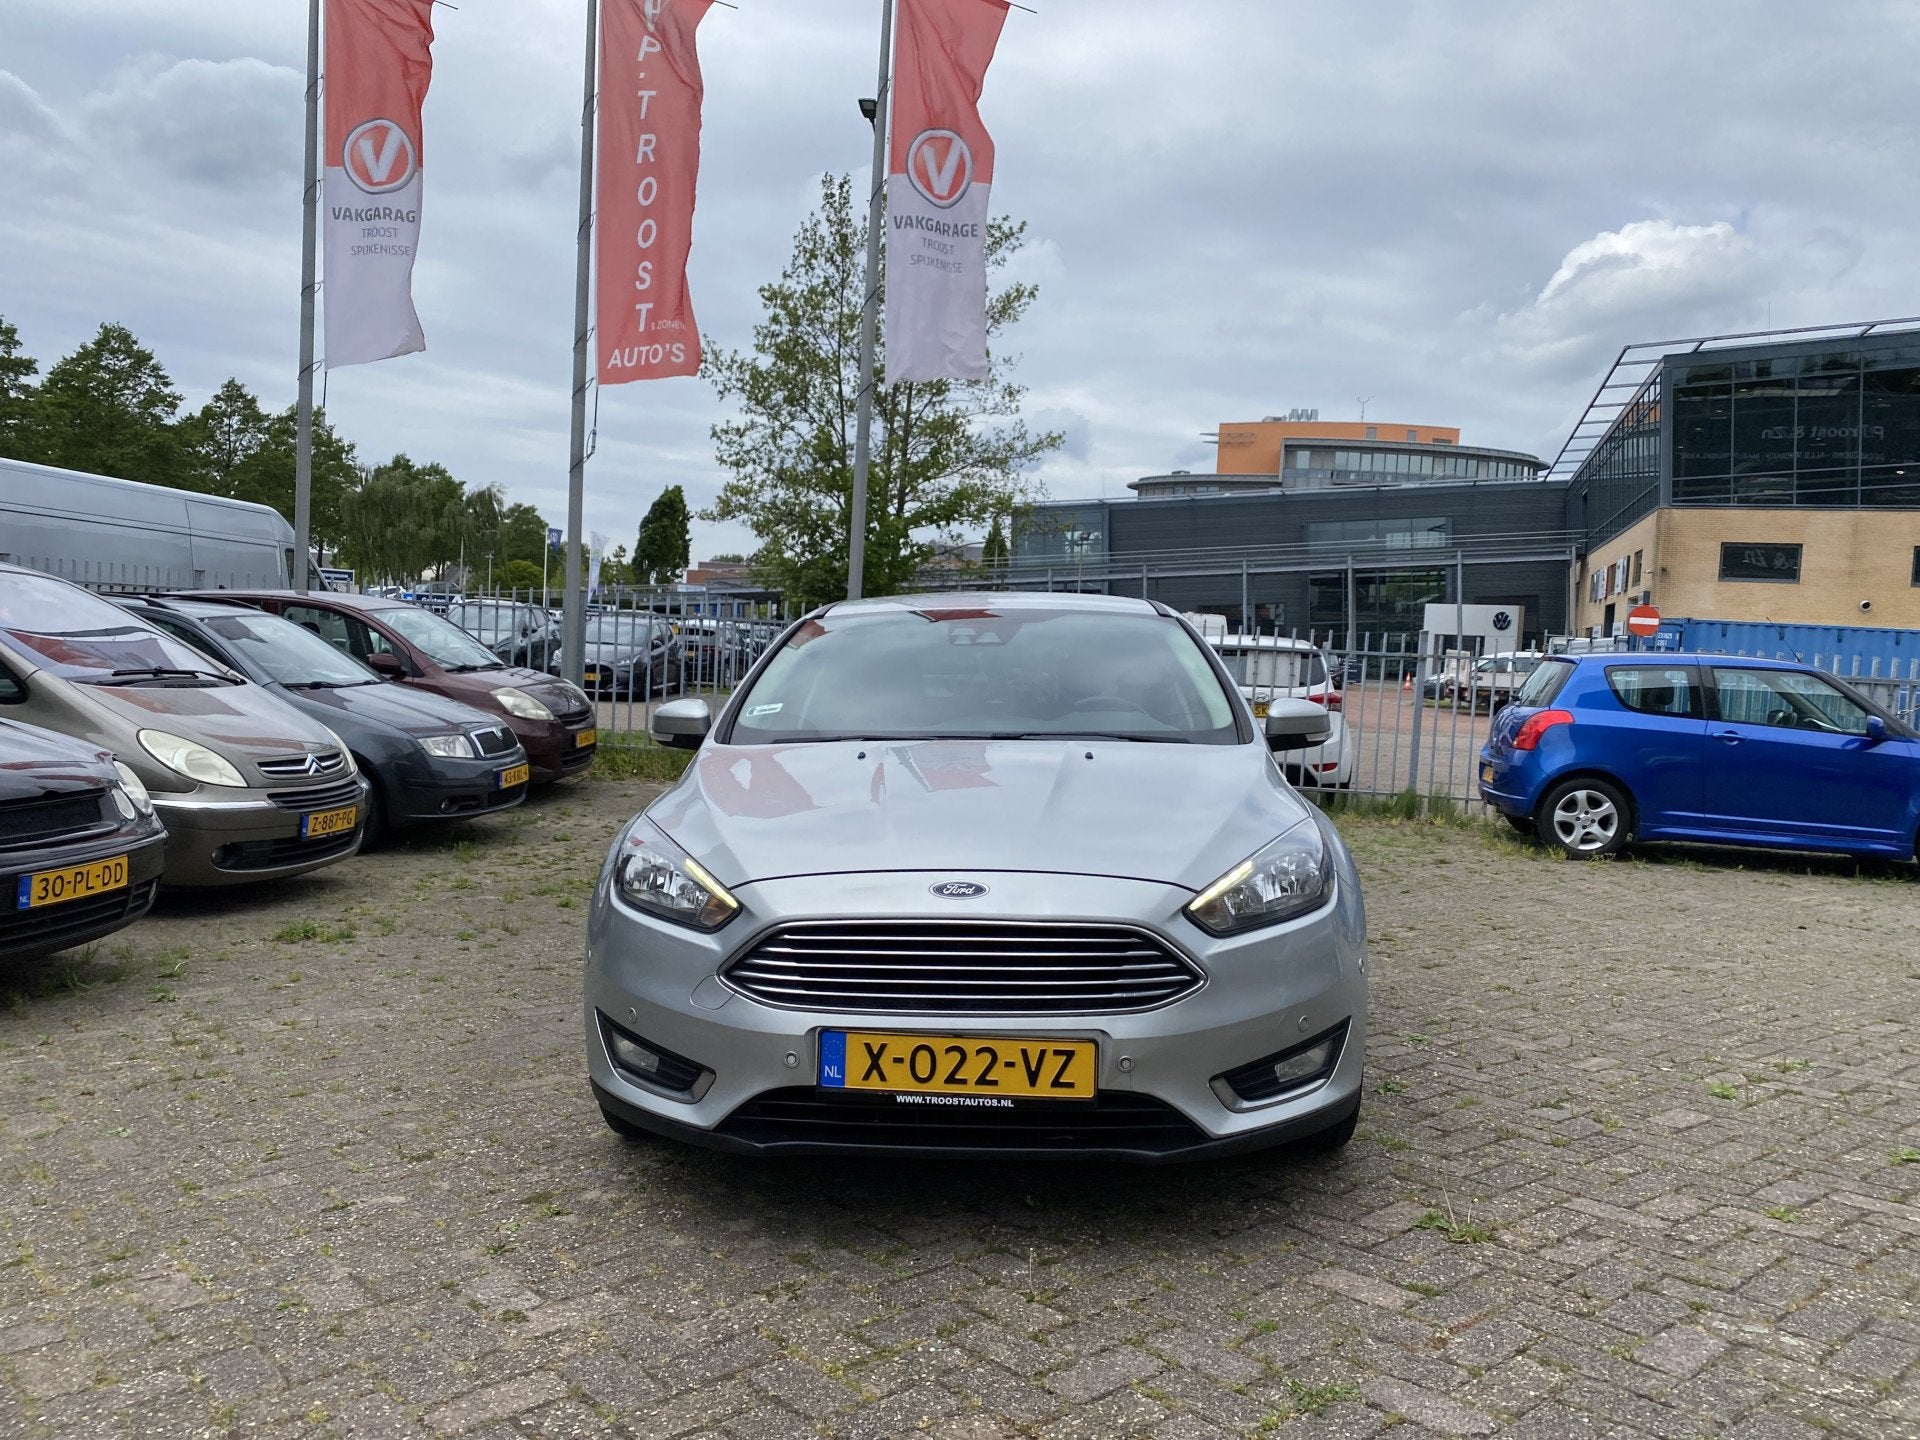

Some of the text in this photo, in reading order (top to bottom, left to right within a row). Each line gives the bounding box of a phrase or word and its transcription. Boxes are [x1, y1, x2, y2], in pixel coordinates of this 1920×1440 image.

[361, 226, 399, 239] TROOST
[893, 214, 979, 239] VAKGARAGE
[606, 342, 686, 369] AUTO'S
[311, 809, 353, 833] Z-887-PG
[37, 862, 124, 901] 30-PL-DD
[942, 883, 976, 895] Ford
[824, 1064, 842, 1079] NL
[861, 1041, 1076, 1089] X-022-VZ
[896, 1094, 1014, 1108] WWW.TROOSTAUTOS.NL
